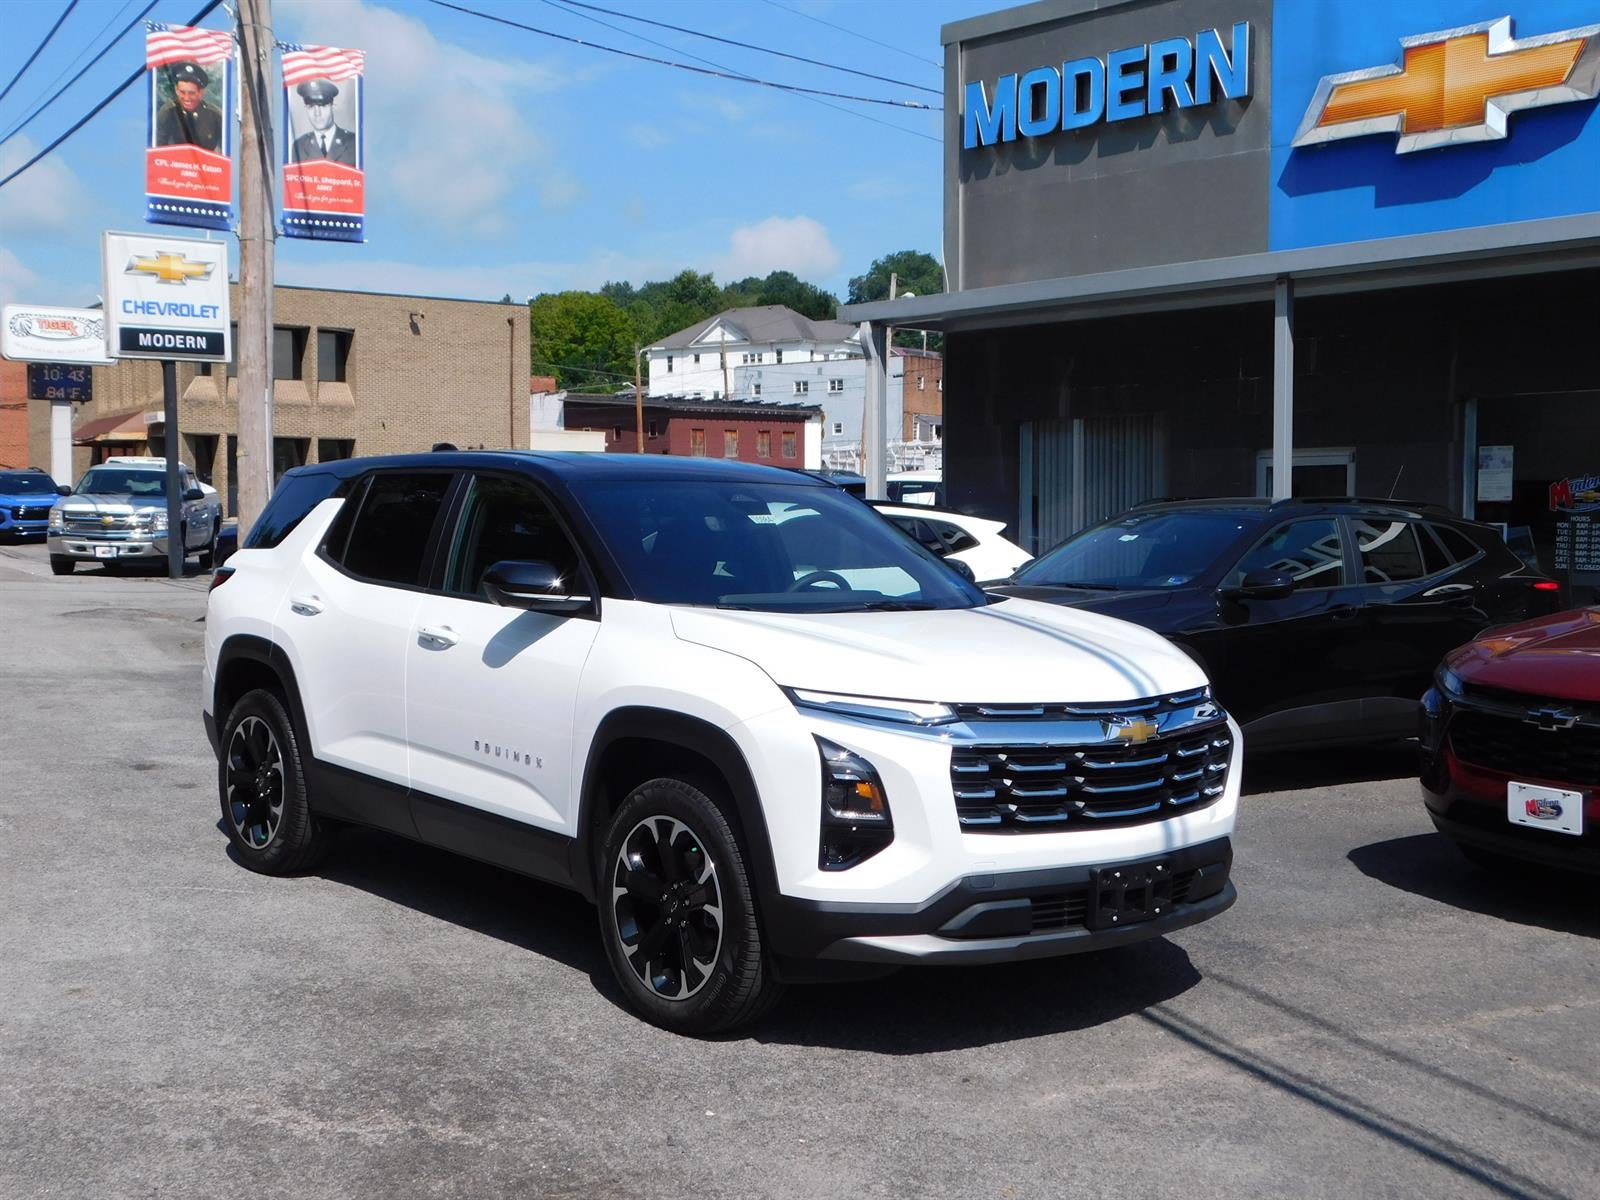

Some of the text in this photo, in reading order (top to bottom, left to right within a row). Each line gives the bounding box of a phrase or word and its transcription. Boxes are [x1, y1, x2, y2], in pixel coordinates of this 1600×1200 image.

[963, 20, 1250, 149] MODERN
[170, 160, 193, 169] James
[202, 164, 223, 173] Eaton
[122, 299, 219, 319] CHEVROLET
[138, 332, 207, 349] MODERN
[43, 368, 85, 382] 10:43
[474, 740, 542, 768] EQUINOX
